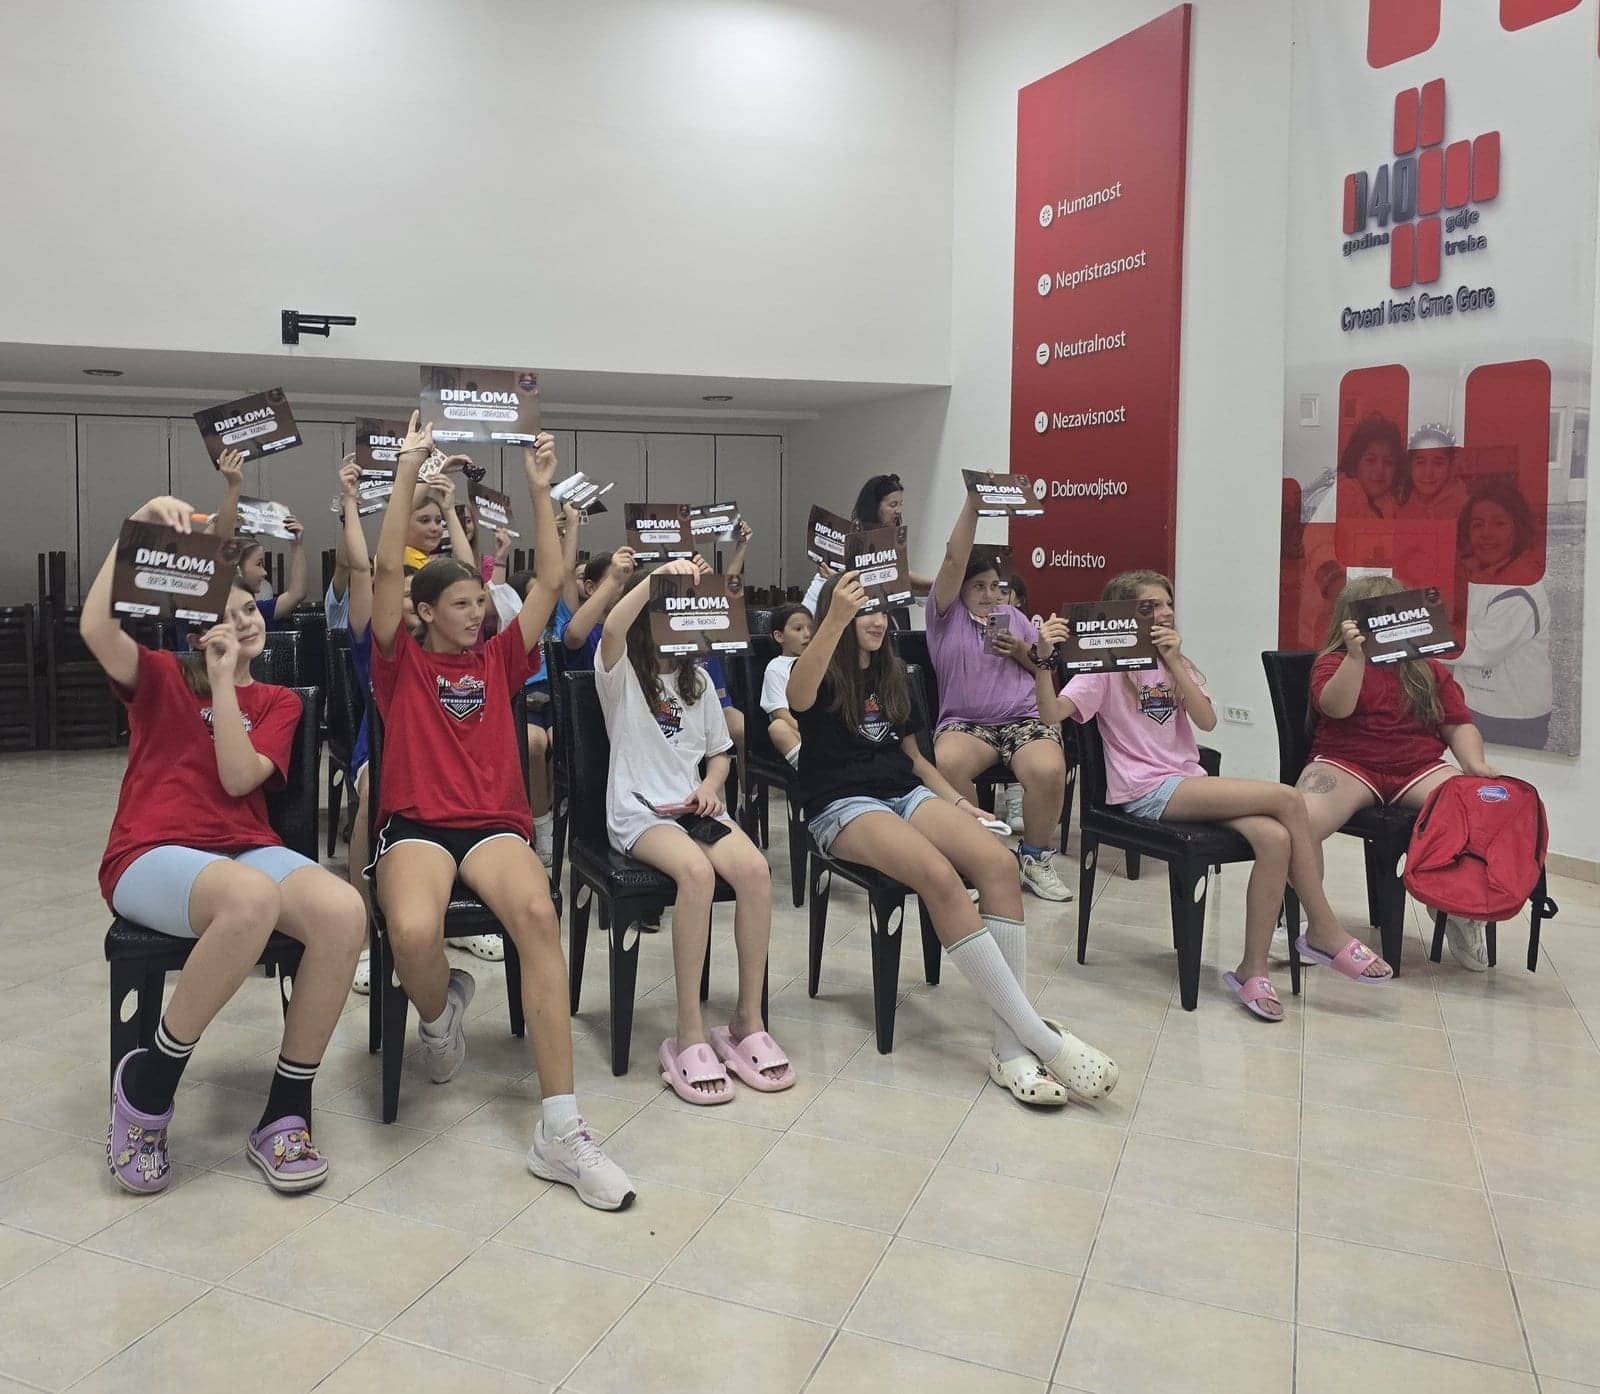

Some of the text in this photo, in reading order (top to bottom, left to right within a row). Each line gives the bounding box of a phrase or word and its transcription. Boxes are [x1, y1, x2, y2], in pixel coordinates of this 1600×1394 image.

[1057, 181, 1122, 218] Humanost
[1445, 208, 1480, 233] gdje
[1342, 232, 1390, 257] godina
[1444, 235, 1487, 256] treba
[1056, 250, 1147, 289] Nepristrasnost
[1341, 285, 1496, 331] Crveni krst Crne Gore
[1054, 330, 1126, 360] Neutralnost
[440, 389, 519, 405] DIPLOMA
[214, 406, 275, 432] DIPLOMA
[1052, 405, 1126, 430] Nezavisnost
[369, 435, 405, 447] DIPLO
[976, 484, 1023, 494] DIPLOMA
[1051, 478, 1128, 500] Dobrovoljstvo
[636, 519, 681, 529] DIPLOMA
[815, 522, 846, 543] DIPLOM
[134, 547, 215, 575] DIPLOMA
[855, 548, 898, 568] DIPLOMA
[1049, 550, 1106, 569] Jedinstvo
[665, 596, 730, 611] DIPLOMA
[1075, 618, 1139, 633] DIPLOMA
[1367, 607, 1431, 629] DIPLOMA
